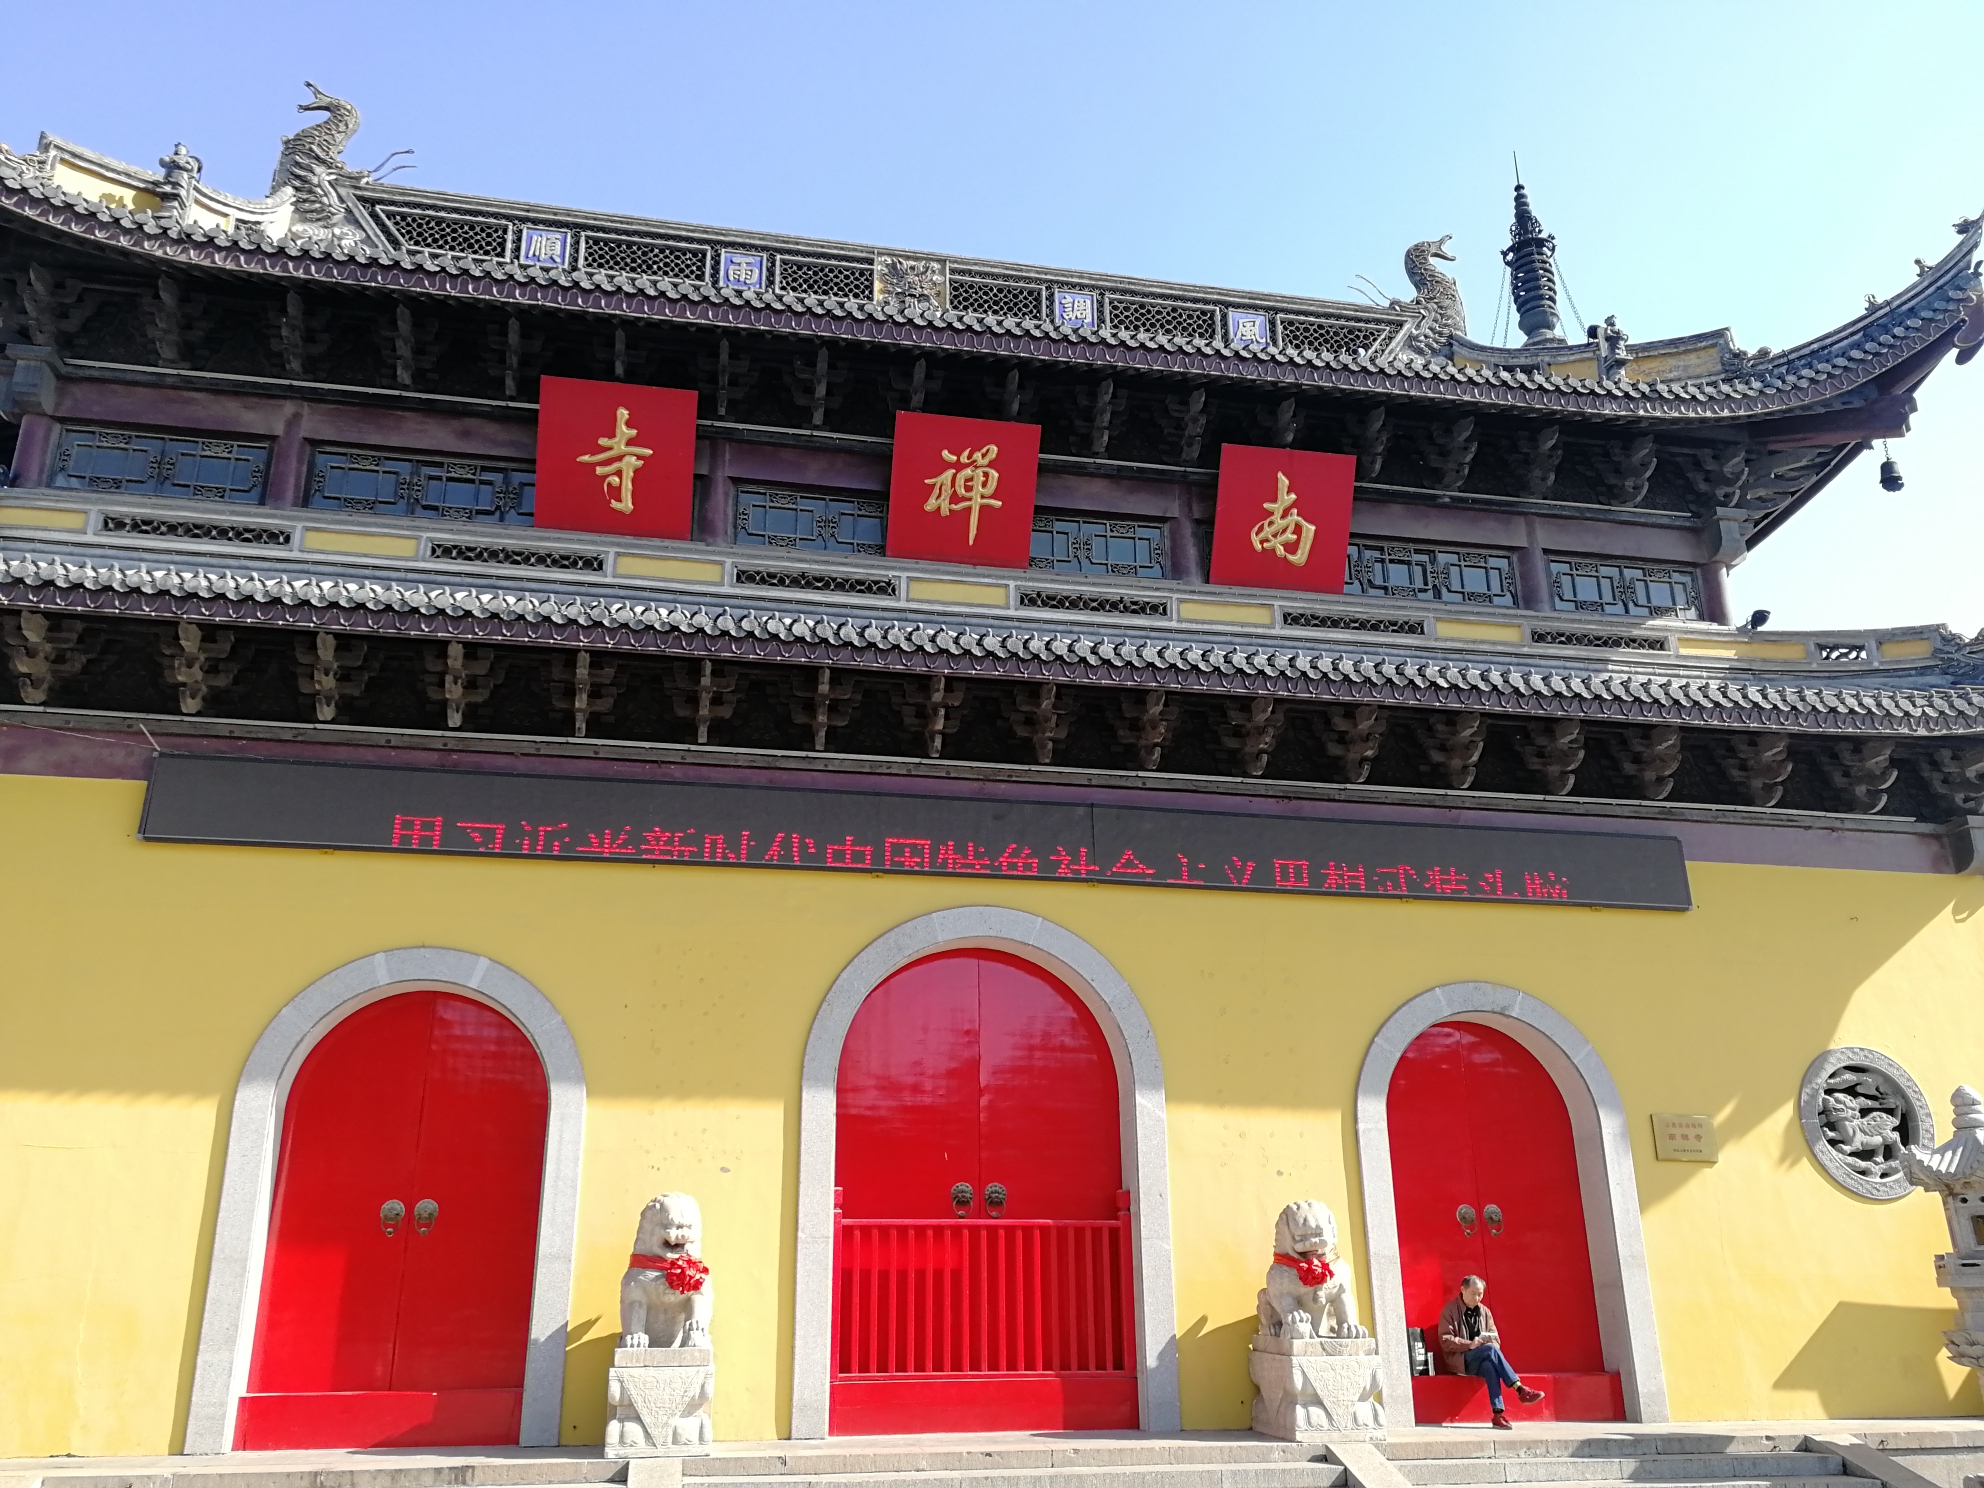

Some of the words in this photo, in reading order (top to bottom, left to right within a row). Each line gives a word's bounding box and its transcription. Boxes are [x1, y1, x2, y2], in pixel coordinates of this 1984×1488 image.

[727, 256, 758, 285] 雨
[1235, 318, 1267, 344] 風
[576, 406, 653, 514] 寺
[1250, 470, 1316, 566] 南
